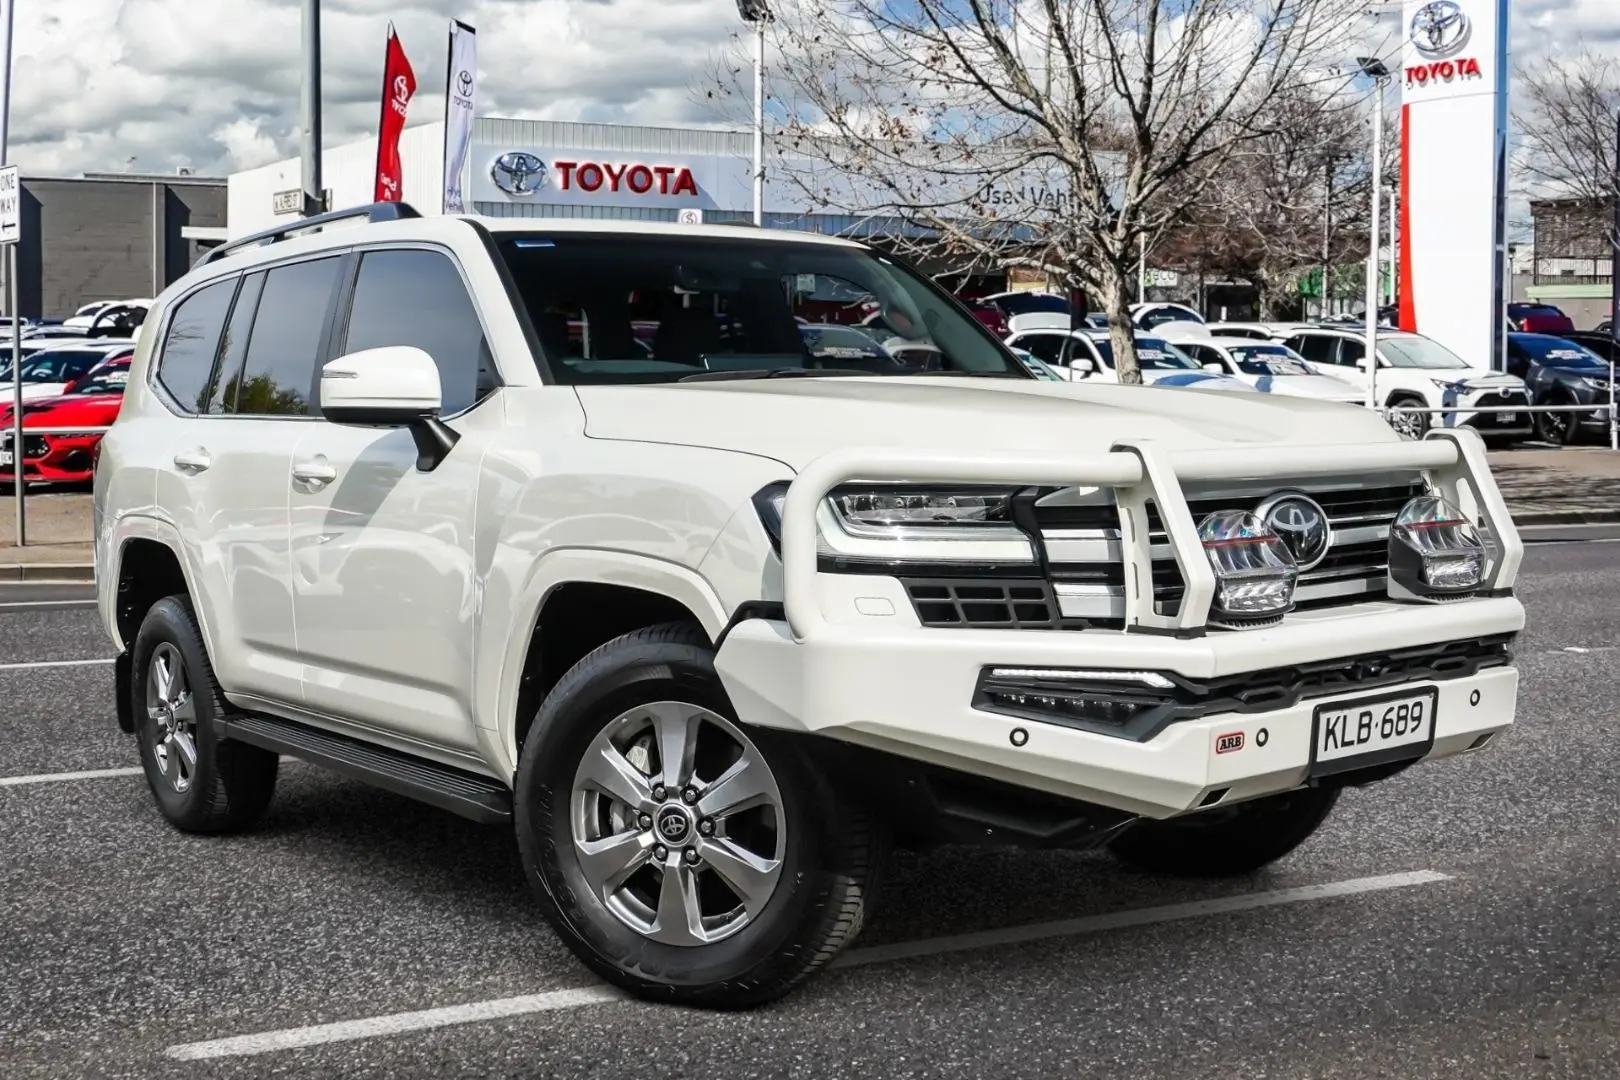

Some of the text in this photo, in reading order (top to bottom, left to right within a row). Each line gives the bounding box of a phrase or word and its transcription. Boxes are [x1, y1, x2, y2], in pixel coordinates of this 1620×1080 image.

[1404, 58, 1481, 84] TOYOTA
[0, 173, 15, 191] ONE
[554, 161, 698, 196] TOYOTA
[0, 196, 16, 214] WAY
[1219, 736, 1242, 750] ARB
